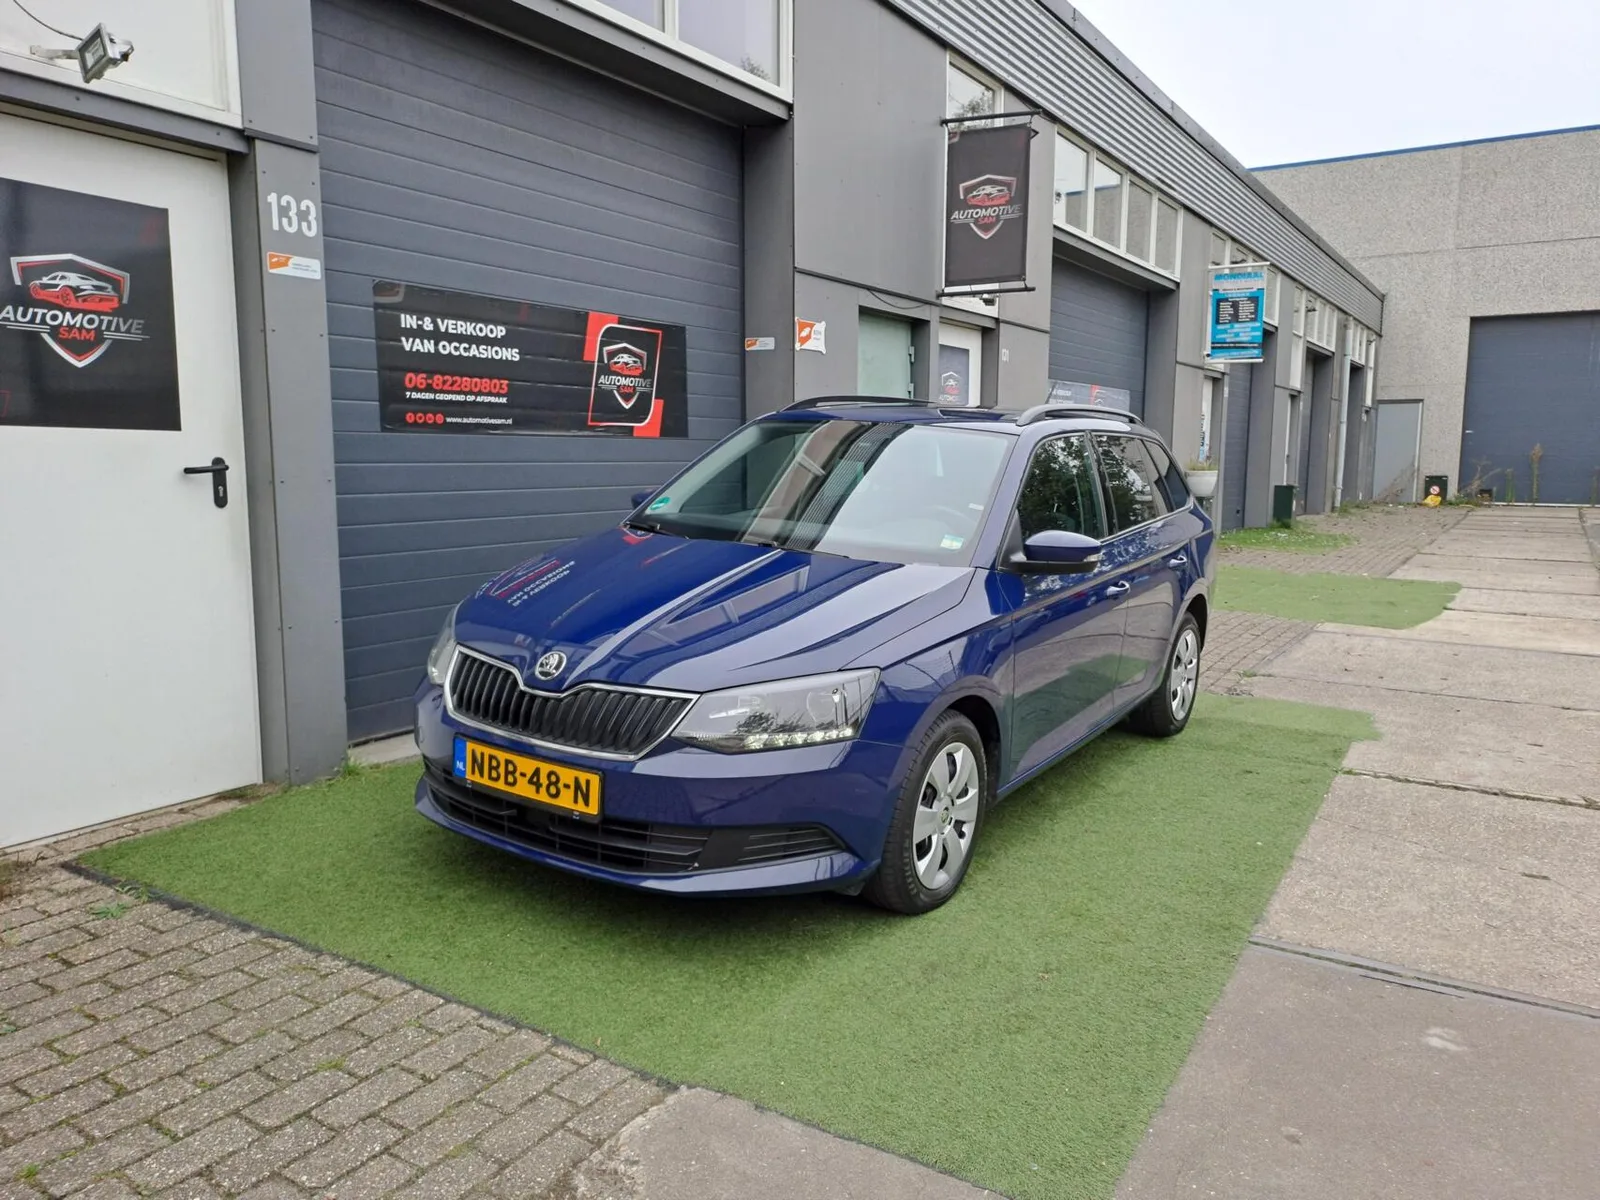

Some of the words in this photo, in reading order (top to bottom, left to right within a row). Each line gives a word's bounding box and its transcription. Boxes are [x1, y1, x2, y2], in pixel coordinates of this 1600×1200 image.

[266, 192, 318, 238] 133
[950, 204, 1021, 220] AUTOMOTIVE
[978, 216, 997, 225] SAM
[0, 305, 145, 334] AUTOMOTIVE
[58, 327, 97, 342] SAM
[437, 318, 507, 339] VERKOOP
[400, 336, 436, 354] VAN
[438, 341, 521, 362] OCCASIONS
[404, 371, 510, 395] 06-82280803
[598, 374, 653, 388] AUTOMOTIVE
[405, 391, 412, 399] 7
[411, 392, 435, 400] DAGEN
[466, 394, 476, 402] OP
[476, 396, 508, 404] AFSPRAAK
[619, 386, 635, 394] SAM
[444, 416, 513, 425] www.automotivesam.nl
[456, 760, 466, 771] NL
[470, 748, 592, 808] NBB-48-N
